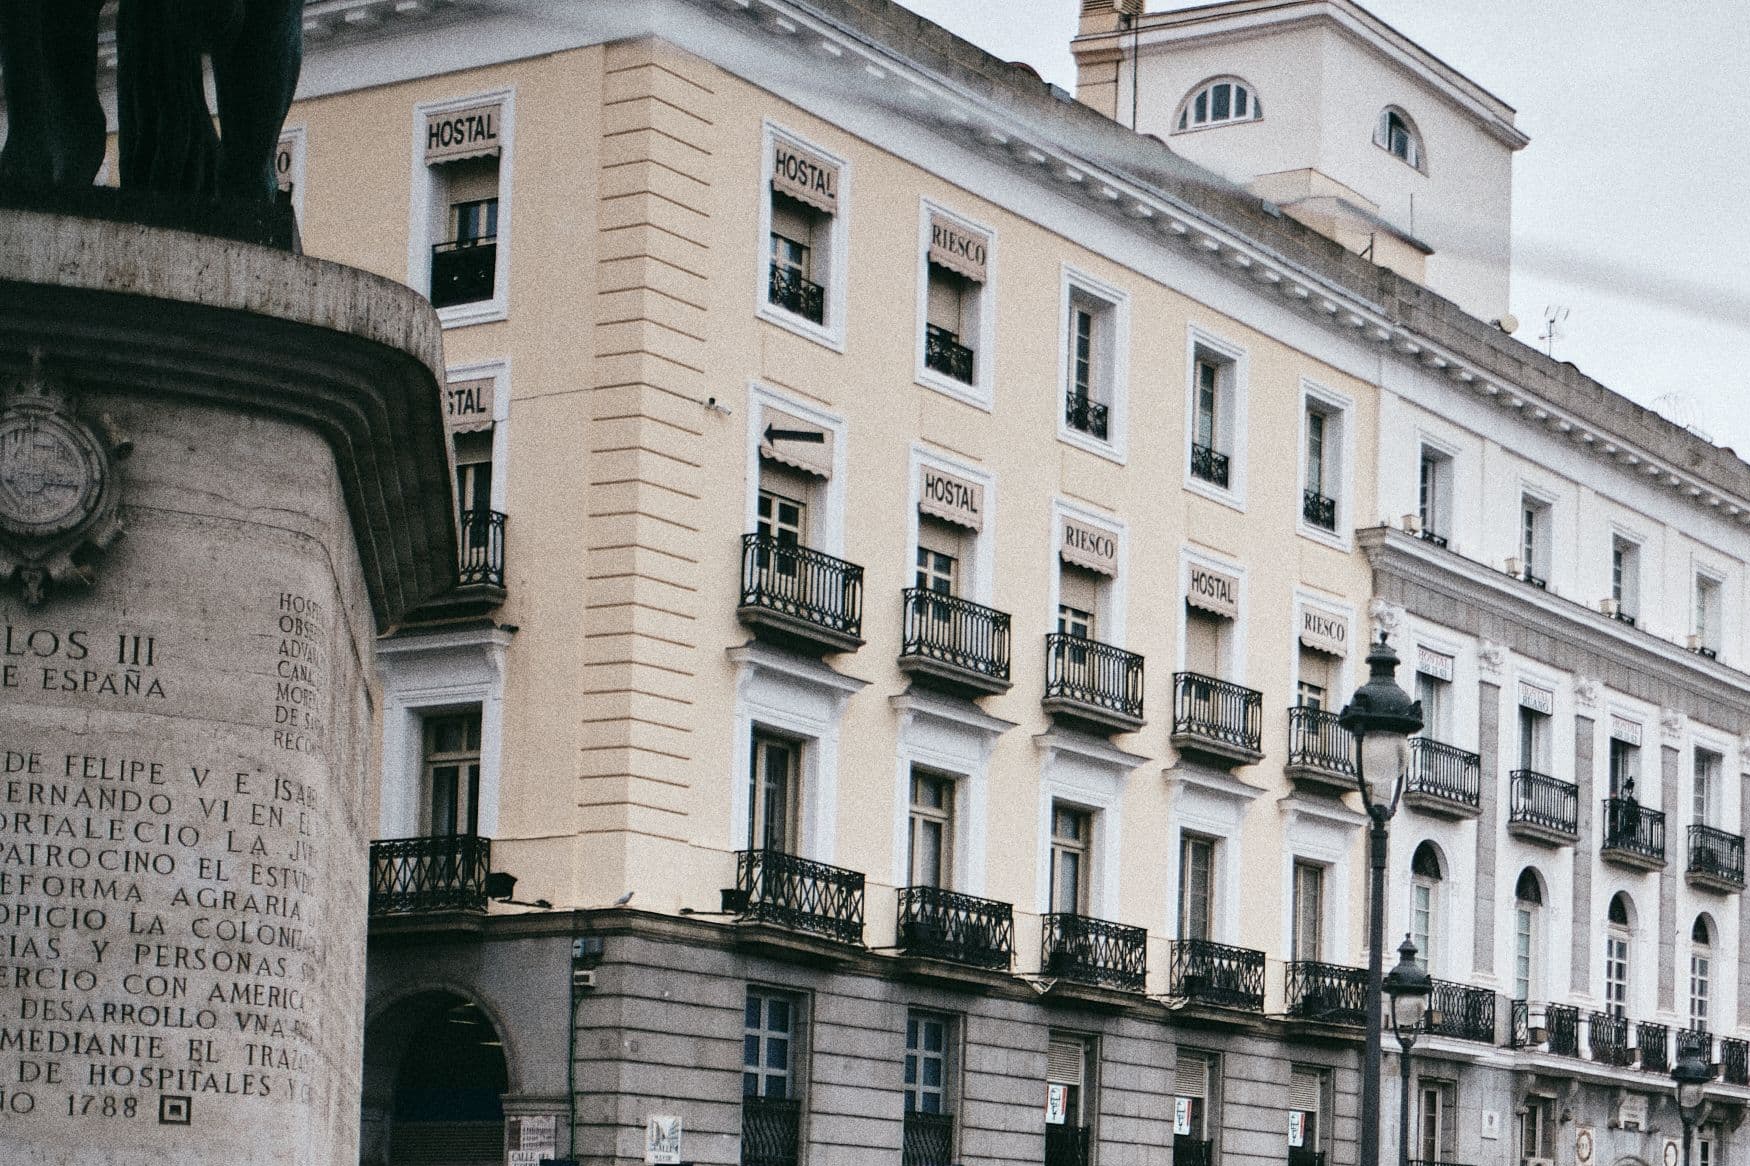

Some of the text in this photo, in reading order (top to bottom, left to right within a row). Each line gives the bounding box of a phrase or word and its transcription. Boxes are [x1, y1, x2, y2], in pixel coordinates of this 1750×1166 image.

[427, 113, 497, 150] HOSTAL
[774, 146, 836, 198] HOSTAL
[931, 224, 986, 267] RIESCO
[923, 473, 979, 514] HOSTAL
[1064, 525, 1116, 562] RIESCO
[1190, 565, 1236, 604] HOSTAL
[1303, 611, 1346, 643] RIESCO
[118, 634, 155, 666] III
[41, 667, 166, 699] ESPAÑA
[275, 705, 298, 727] DE
[5, 751, 42, 774] DE
[65, 754, 166, 786] FELIPE
[191, 767, 211, 788] V
[236, 773, 251, 795] E
[7, 781, 171, 815] ERNANDO
[199, 797, 229, 822] VI
[250, 803, 283, 827] EN
[227, 829, 268, 856] LA
[199, 857, 229, 882] EL
[170, 887, 301, 921] AGRARIA
[130, 911, 165, 935] LA
[91, 939, 110, 963] Y
[123, 973, 188, 998] CON
[20, 997, 217, 1030] DESARROLLO
[234, 1011, 285, 1039] VNA
[0, 1028, 165, 1059] MEDIANTE
[188, 1039, 219, 1064] EL
[18, 1060, 63, 1085] DE
[88, 1063, 271, 1097] HOSPITALES
[67, 1093, 138, 1118] 1788
